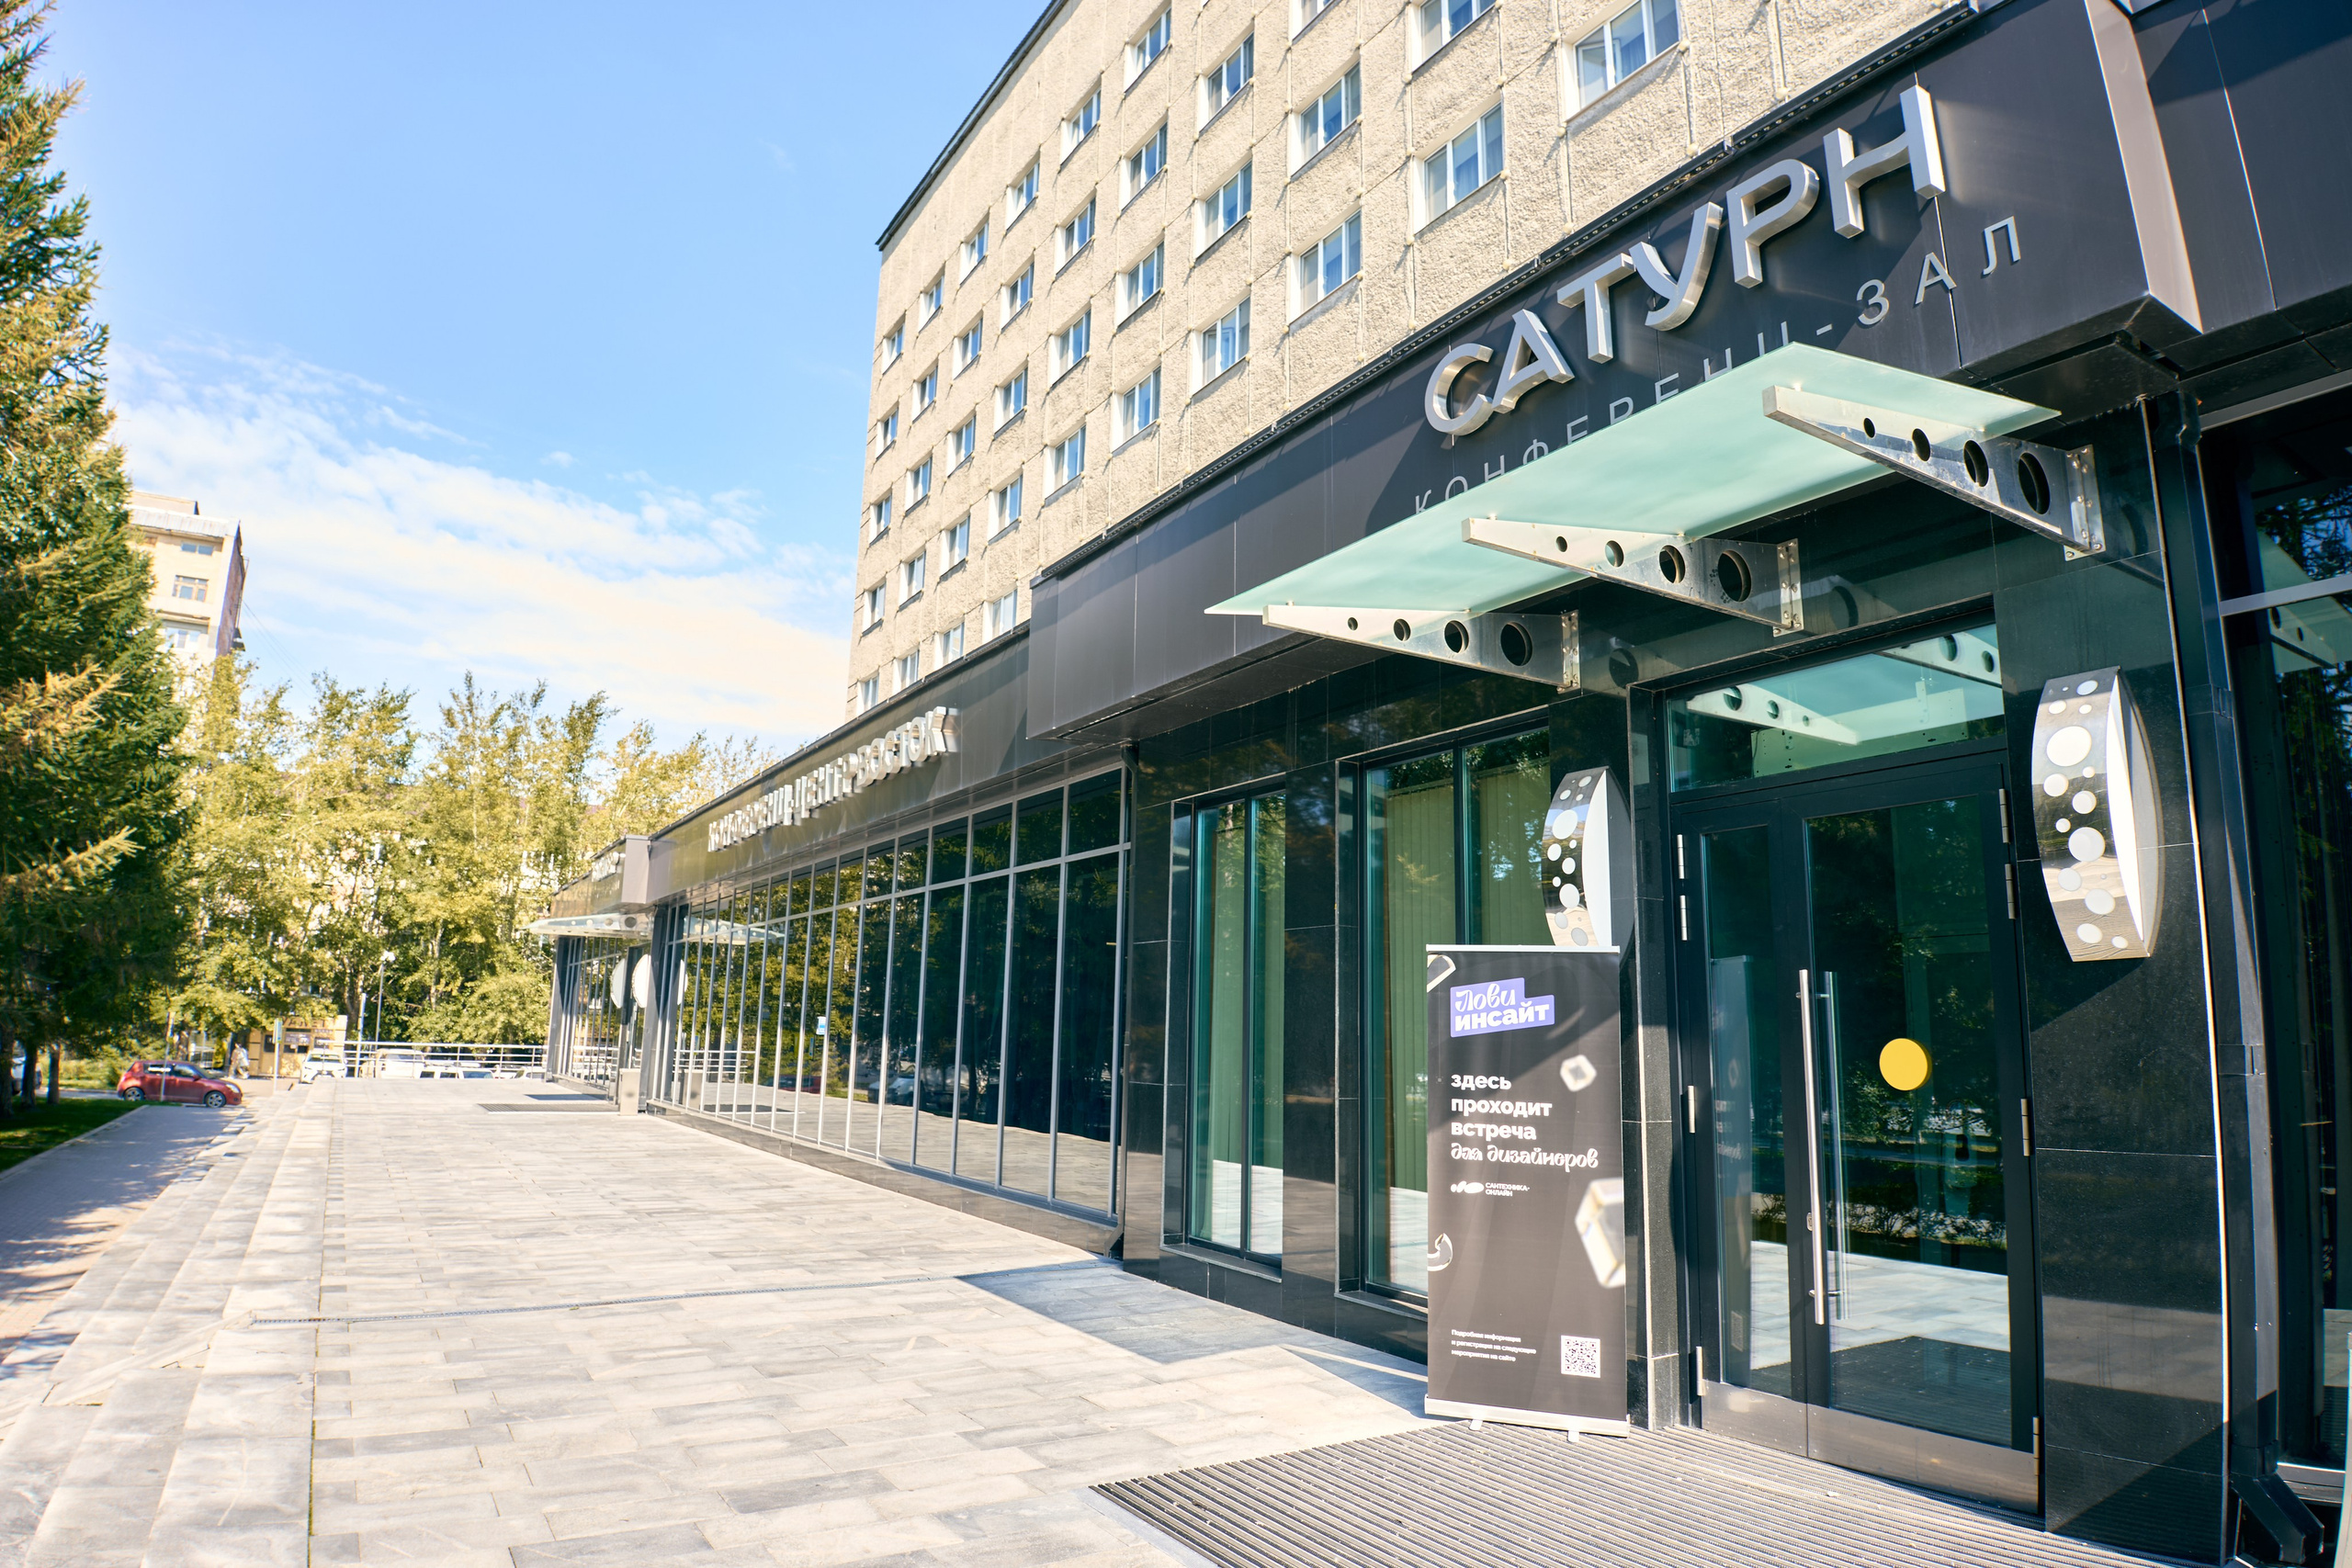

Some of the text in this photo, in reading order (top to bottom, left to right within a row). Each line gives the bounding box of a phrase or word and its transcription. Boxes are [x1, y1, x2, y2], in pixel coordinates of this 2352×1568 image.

[1424, 84, 1947, 436] САТУРН
[856, 705, 947, 787] ВОСТОК
[1455, 984, 1516, 1012] Лови
[1455, 1001, 1550, 1032] инсайт
[1451, 1074, 1511, 1090] здесь
[1451, 1098, 1553, 1118] проходит
[1451, 1122, 1537, 1142] встреча
[1451, 1143, 1599, 1172] для дизайнеров
[1486, 1189, 1513, 1197] ОНЛАЙН
